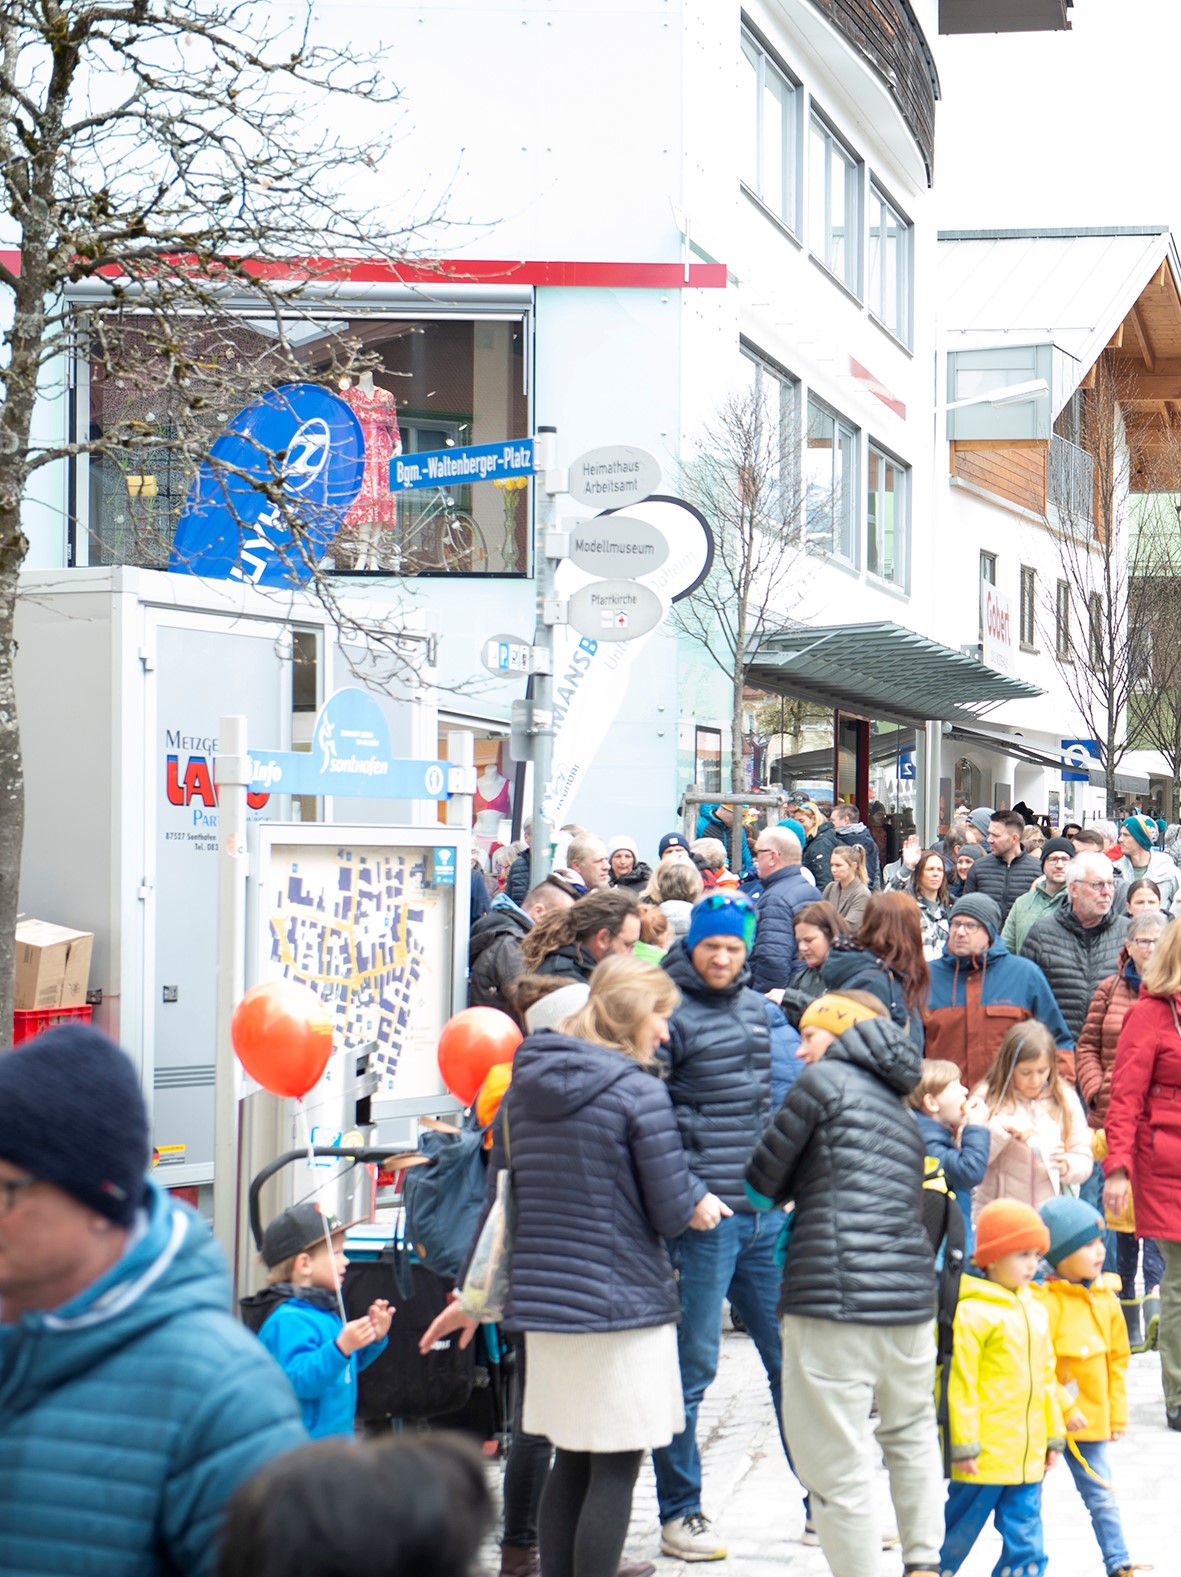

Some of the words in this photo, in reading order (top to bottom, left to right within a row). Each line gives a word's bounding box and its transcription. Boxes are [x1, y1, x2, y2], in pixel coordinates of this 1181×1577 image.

[396, 446, 531, 487] Bgm.-Waltenberger-Platz
[583, 461, 640, 477] Heimathaus
[585, 479, 638, 494] Arbeitsamt
[575, 538, 655, 555] Modellmuseum
[591, 593, 638, 606] Pfarrkirche
[165, 832, 185, 840] 87527
[187, 833, 217, 842] Sonthofen
[195, 843, 206, 851] Tel.
